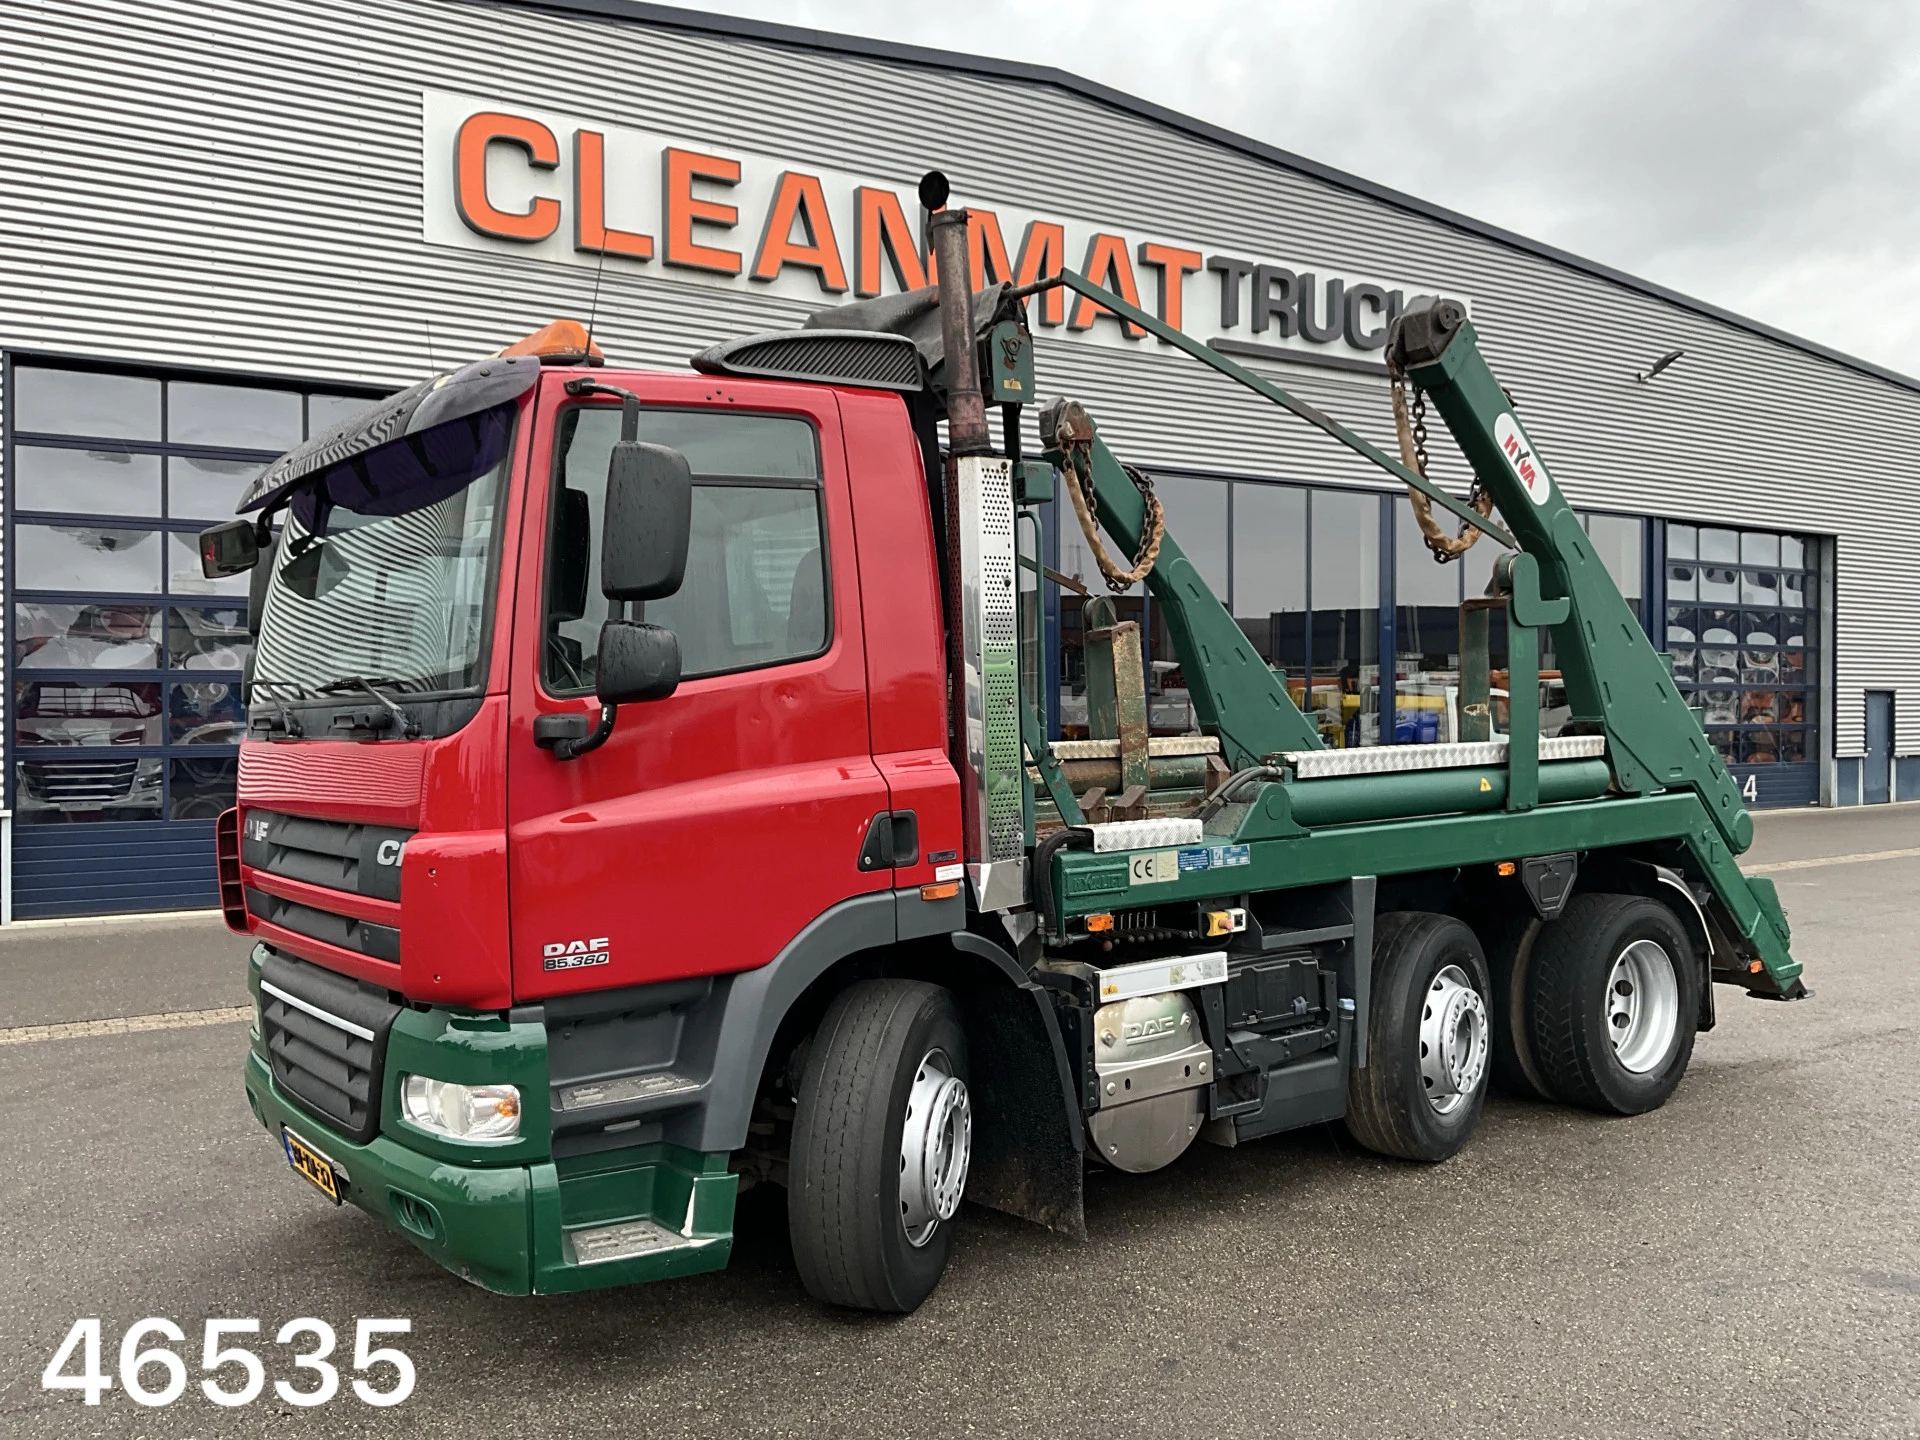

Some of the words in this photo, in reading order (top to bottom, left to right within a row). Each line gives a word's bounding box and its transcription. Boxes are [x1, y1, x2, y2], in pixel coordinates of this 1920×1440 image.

[454, 111, 1202, 343] CLEANMAT
[1207, 255, 1467, 350] TRUC
[1504, 433, 1536, 491] HYVA
[543, 937, 609, 957] DAF
[545, 953, 608, 970] 85.360
[1124, 1015, 1175, 1039] DAF
